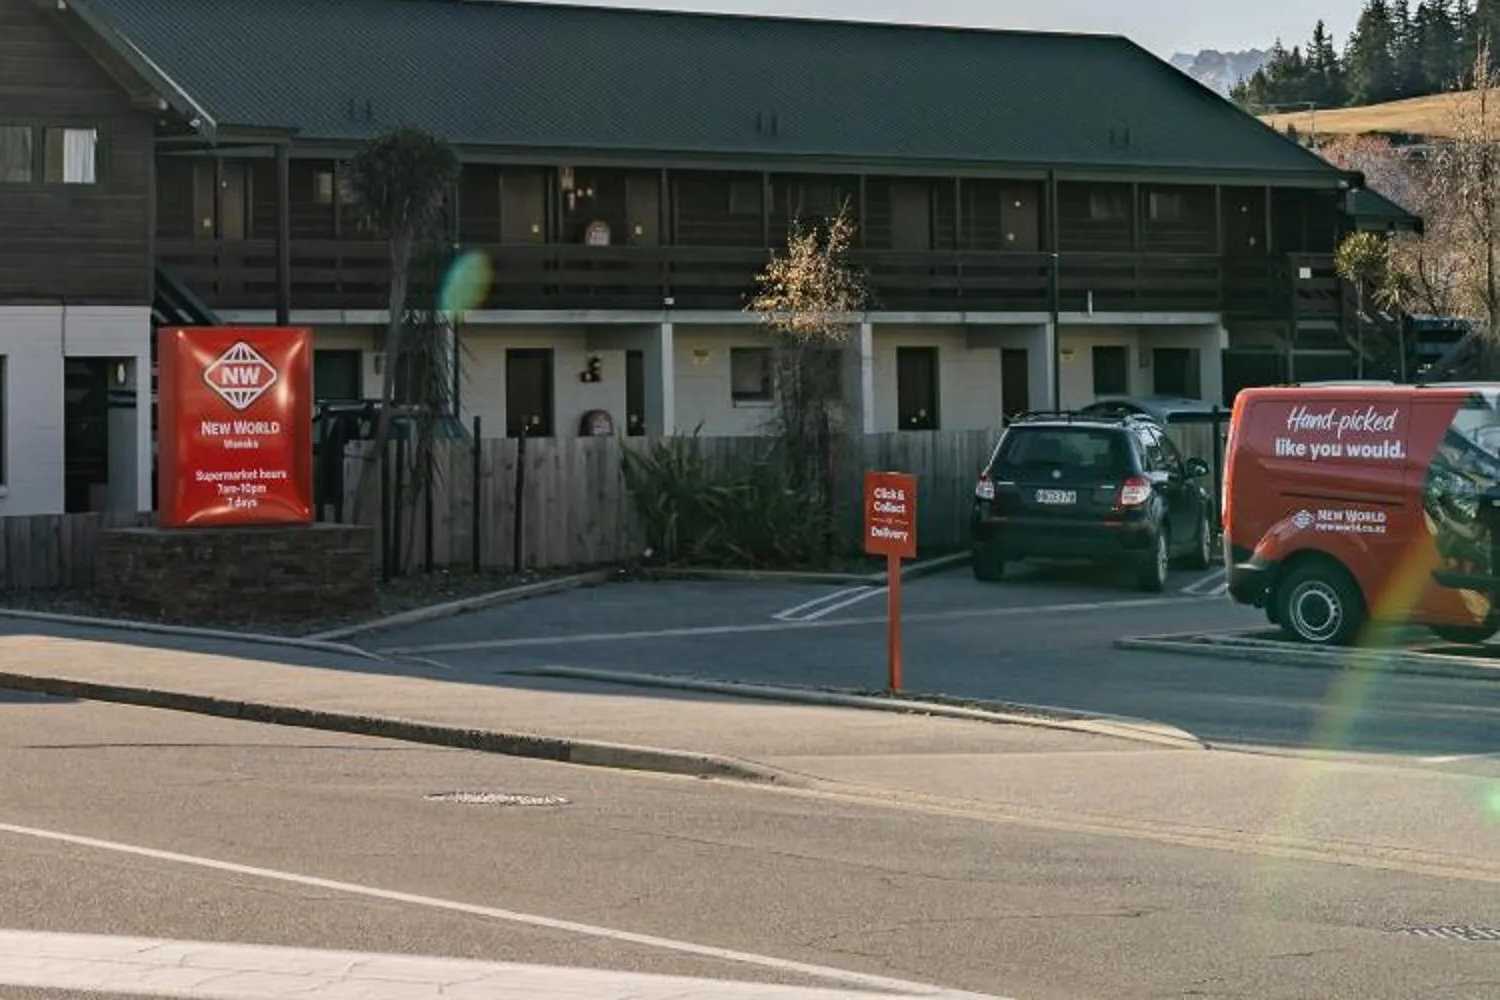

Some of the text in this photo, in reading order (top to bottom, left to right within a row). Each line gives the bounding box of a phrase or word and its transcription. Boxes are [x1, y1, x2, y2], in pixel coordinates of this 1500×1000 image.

[221, 367, 260, 385] NW
[201, 420, 280, 436] NEW WORLD
[1287, 405, 1399, 440] Hand-picked
[1276, 438, 1406, 461] like you would.
[195, 468, 287, 482] Supermarket hours
[873, 487, 897, 500] Click
[227, 496, 258, 509] 7 days
[873, 501, 906, 514] Collect
[1317, 509, 1343, 521] NEW
[1345, 510, 1387, 523] WORLD
[871, 526, 909, 543] Delivery
